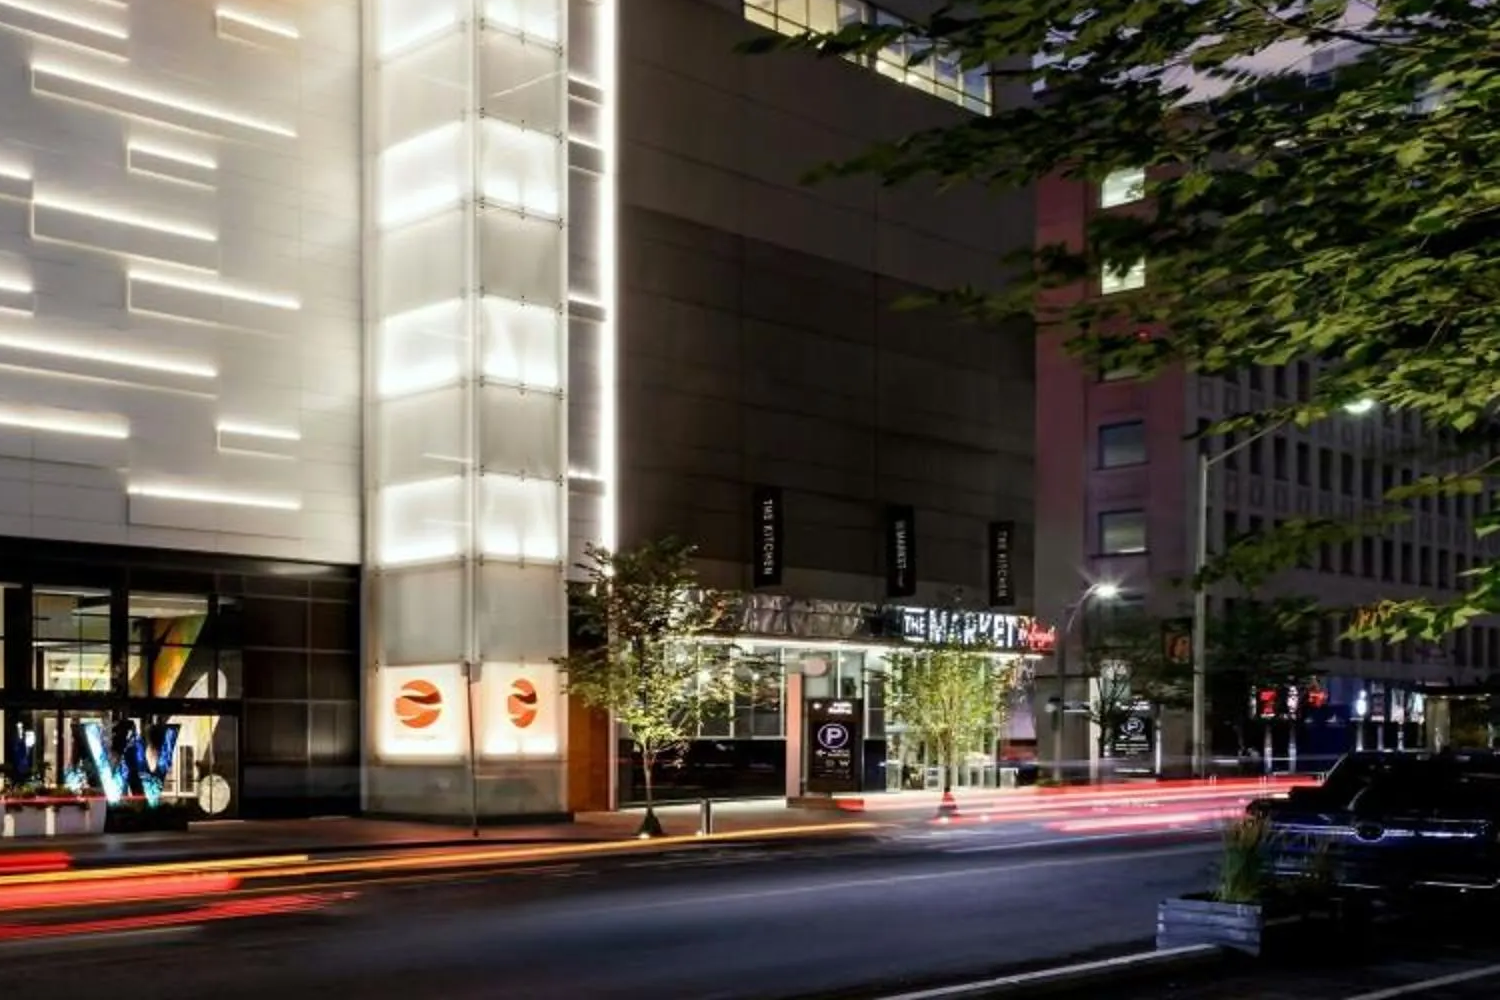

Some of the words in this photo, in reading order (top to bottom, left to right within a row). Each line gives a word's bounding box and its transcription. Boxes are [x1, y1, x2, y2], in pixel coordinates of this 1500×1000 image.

[763, 525, 774, 575] KITCHEN
[904, 615, 927, 634] THE
[929, 608, 1018, 648] MARKET
[826, 728, 842, 744] P
